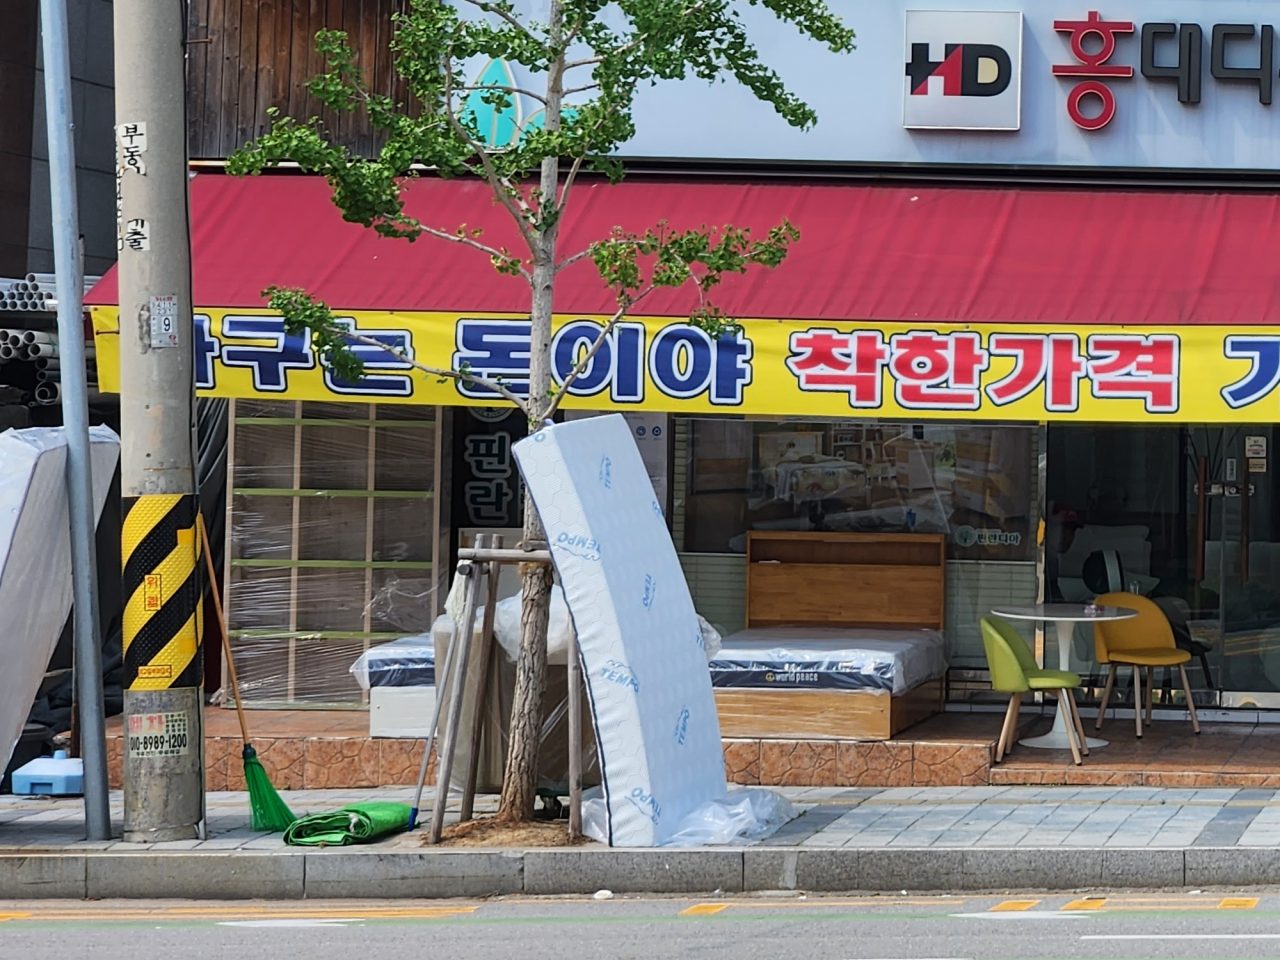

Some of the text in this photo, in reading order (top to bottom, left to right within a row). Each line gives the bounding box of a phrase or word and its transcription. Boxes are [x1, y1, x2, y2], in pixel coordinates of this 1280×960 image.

[905, 43, 1012, 96] HD
[121, 124, 146, 176] 부동
[163, 317, 171, 331] 9
[452, 319, 753, 406] 돈이야
